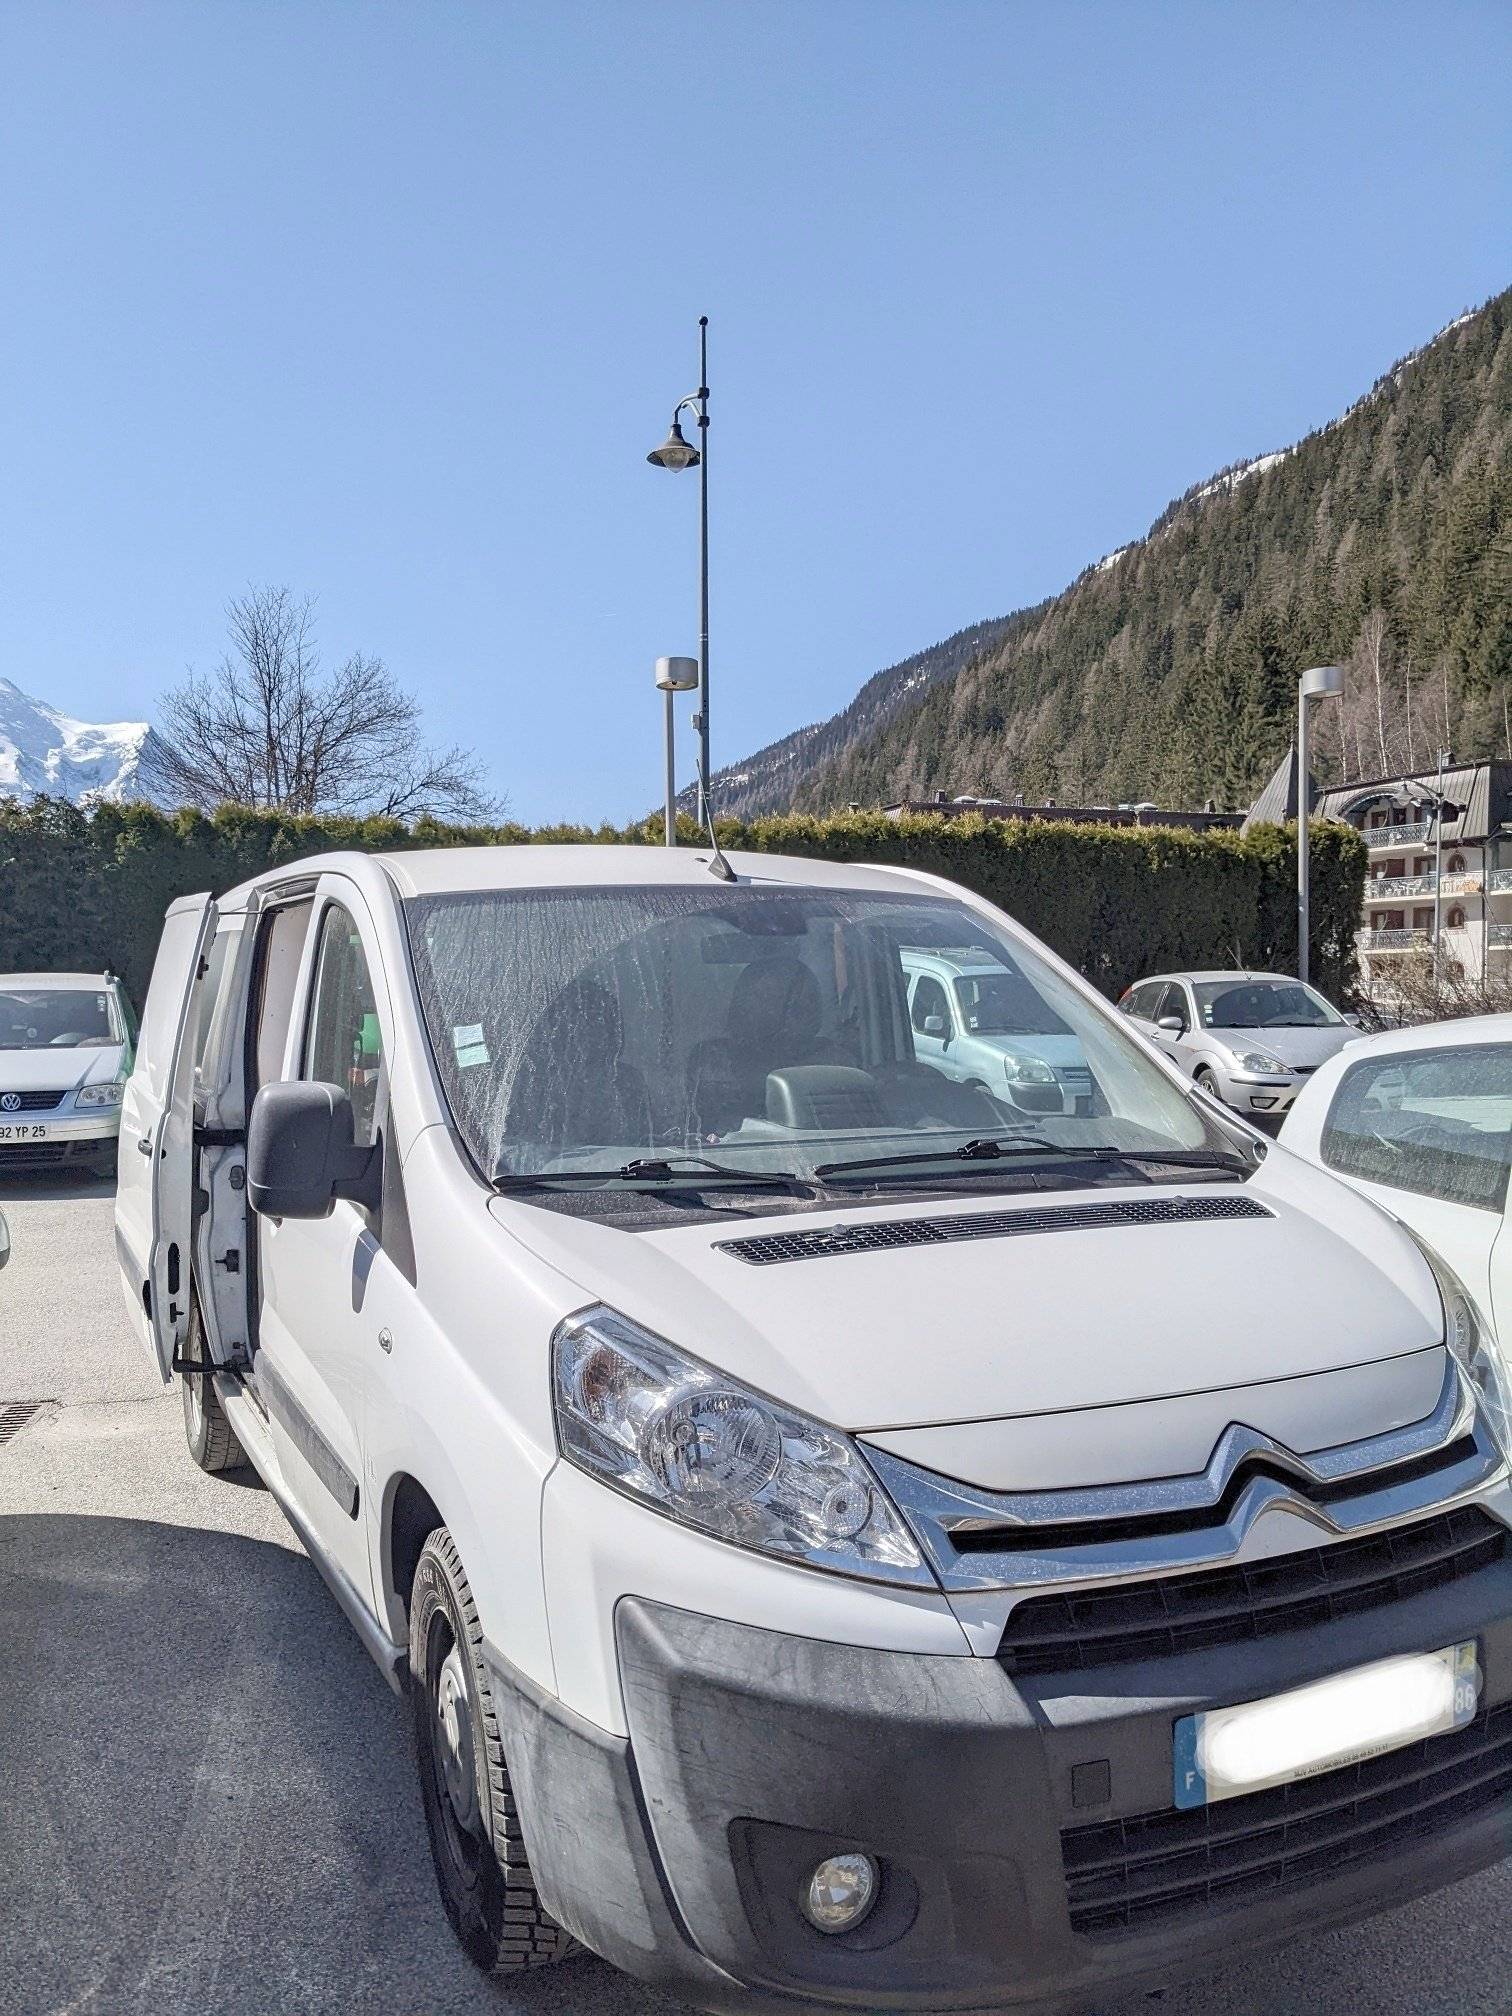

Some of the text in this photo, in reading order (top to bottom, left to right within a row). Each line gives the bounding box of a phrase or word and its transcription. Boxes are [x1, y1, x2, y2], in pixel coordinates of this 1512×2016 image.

[15, 1126, 29, 1138] YP
[32, 1126, 46, 1138] 25
[1455, 1684, 1475, 1713] 86
[1185, 1771, 1196, 1791] F
